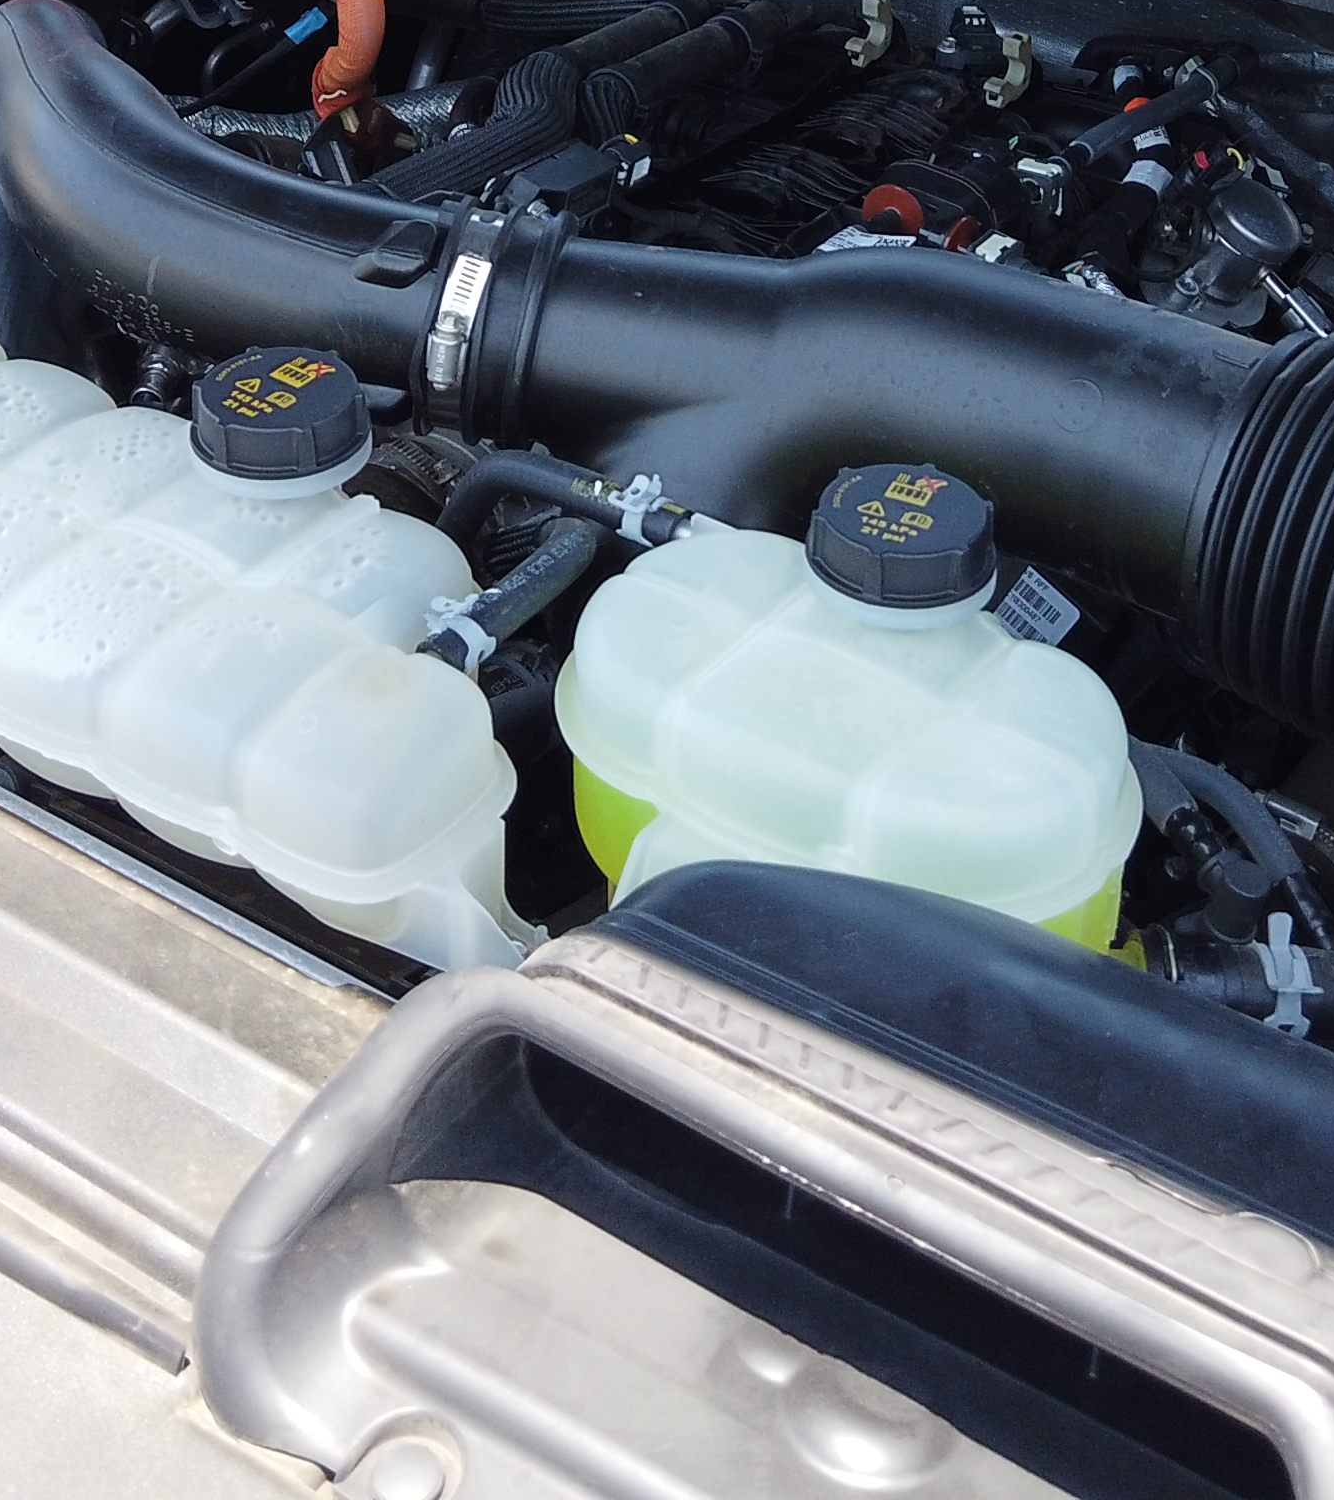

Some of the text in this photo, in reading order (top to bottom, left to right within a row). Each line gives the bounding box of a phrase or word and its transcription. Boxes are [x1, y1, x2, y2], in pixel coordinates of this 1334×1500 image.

[859, 525, 907, 544] 21 psi
[860, 515, 919, 537] 145 kPa
